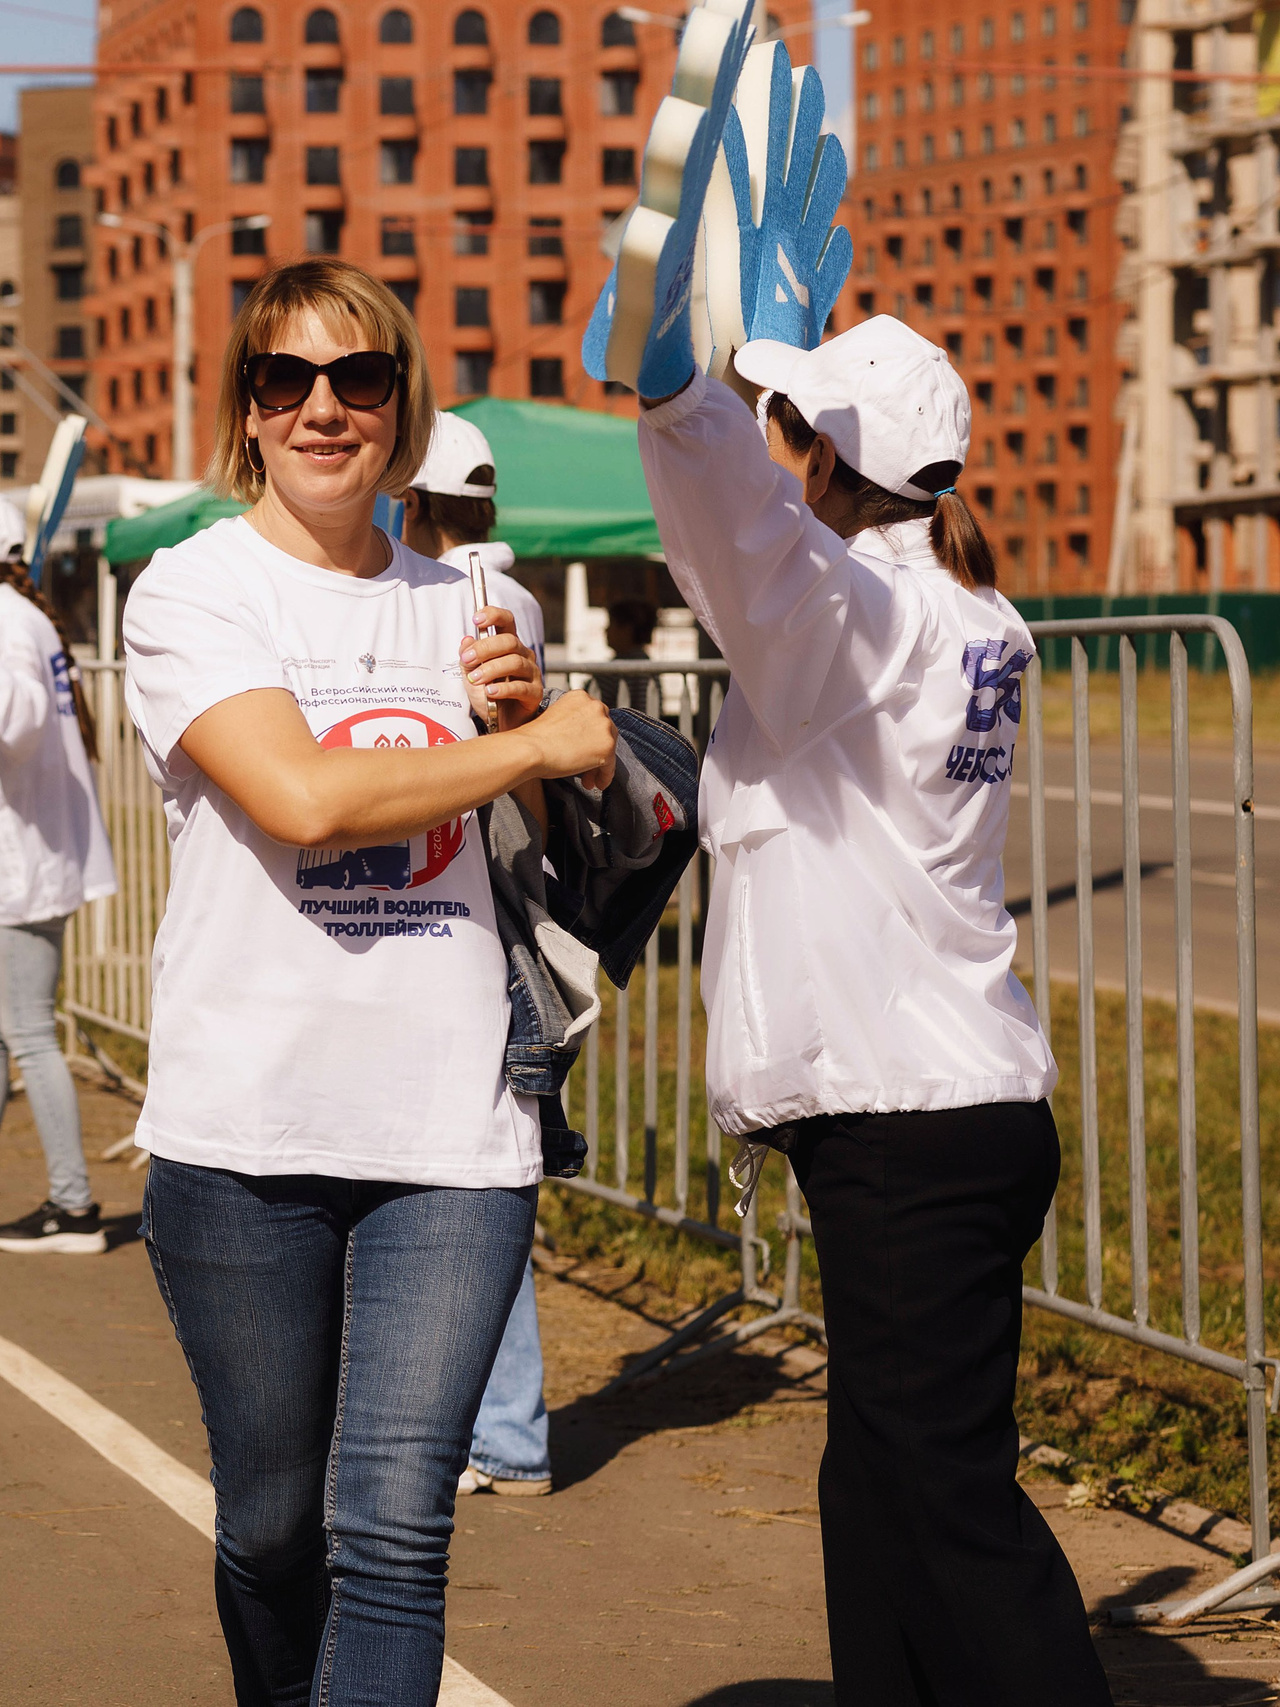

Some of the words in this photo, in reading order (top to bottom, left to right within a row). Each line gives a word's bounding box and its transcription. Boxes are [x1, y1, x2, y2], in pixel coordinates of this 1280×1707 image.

[311, 685, 398, 697] Всероссийский
[401, 686, 441, 697] конкурс
[298, 696, 406, 708] рофессионального
[408, 696, 463, 709] мастерства
[433, 826, 442, 859] 2024
[298, 897, 379, 915] ЛУЧШИЙ
[383, 899, 470, 918] ВОДИТЕЛЬ
[324, 919, 453, 937] ТРОЛЛЕЙБУСА
